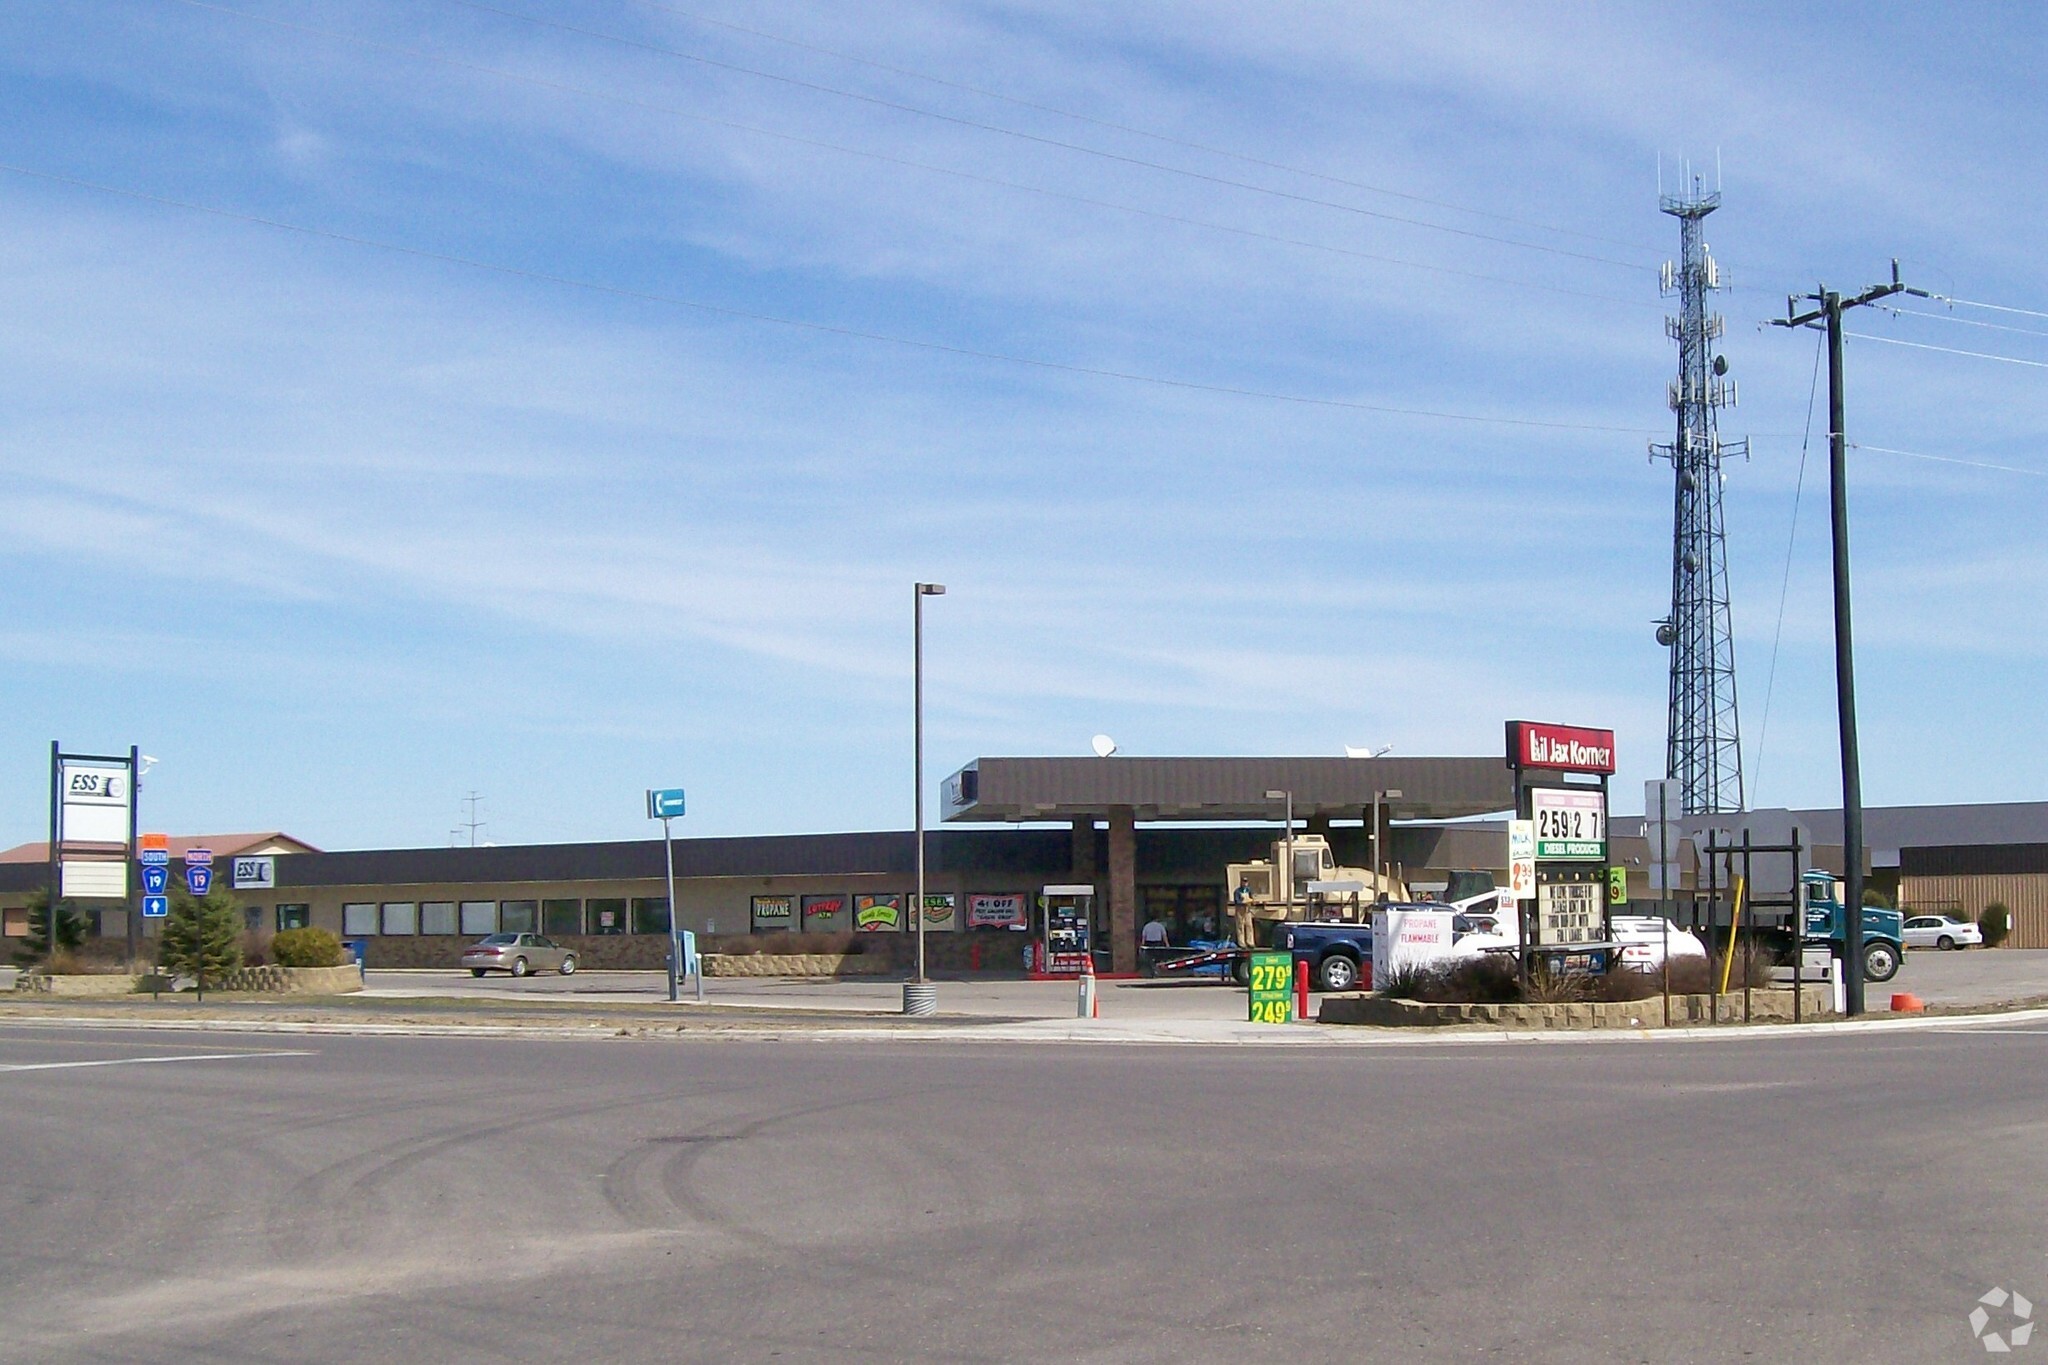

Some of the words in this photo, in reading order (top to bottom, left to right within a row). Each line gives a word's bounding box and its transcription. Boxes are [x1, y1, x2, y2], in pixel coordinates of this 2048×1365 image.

[1550, 738, 1569, 763] Jax
[1570, 740, 1610, 767] Korner
[71, 774, 99, 790] ESS
[1512, 833, 1532, 845] MILK
[237, 862, 255, 877] ESS
[150, 876, 162, 888] 19
[194, 875, 206, 887] 19
[756, 903, 790, 916] PROPANE
[807, 899, 842, 915] LOTTERY
[993, 899, 1013, 908] OFF
[818, 911, 833, 919] ATM
[1404, 919, 1437, 929] PROPANE
